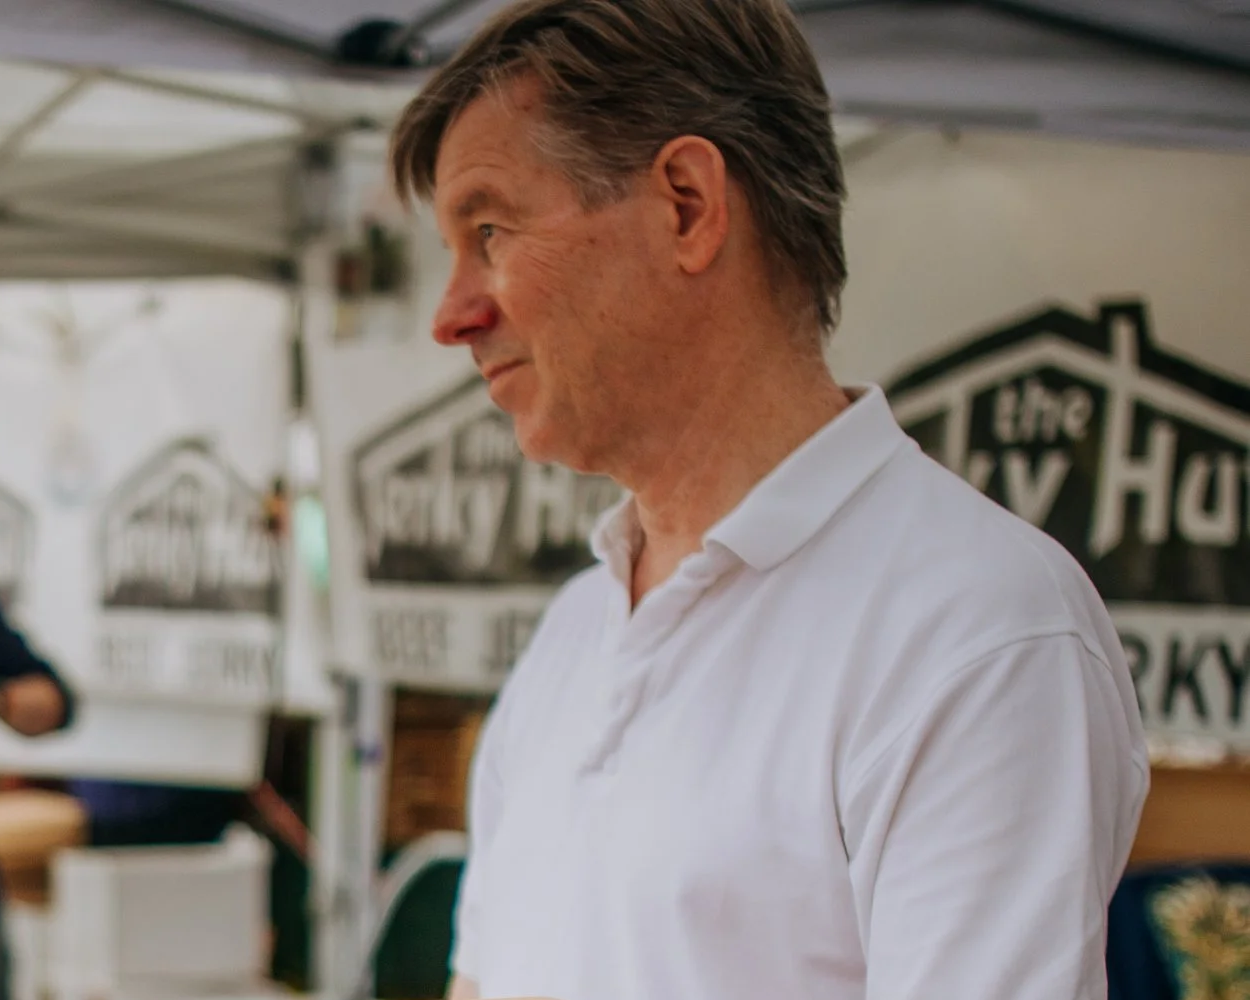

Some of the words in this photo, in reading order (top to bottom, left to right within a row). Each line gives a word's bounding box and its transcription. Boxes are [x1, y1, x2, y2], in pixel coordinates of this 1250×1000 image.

[992, 374, 1094, 441] the
[1088, 395, 1250, 562] Hu
[1123, 632, 1250, 729] RKY
